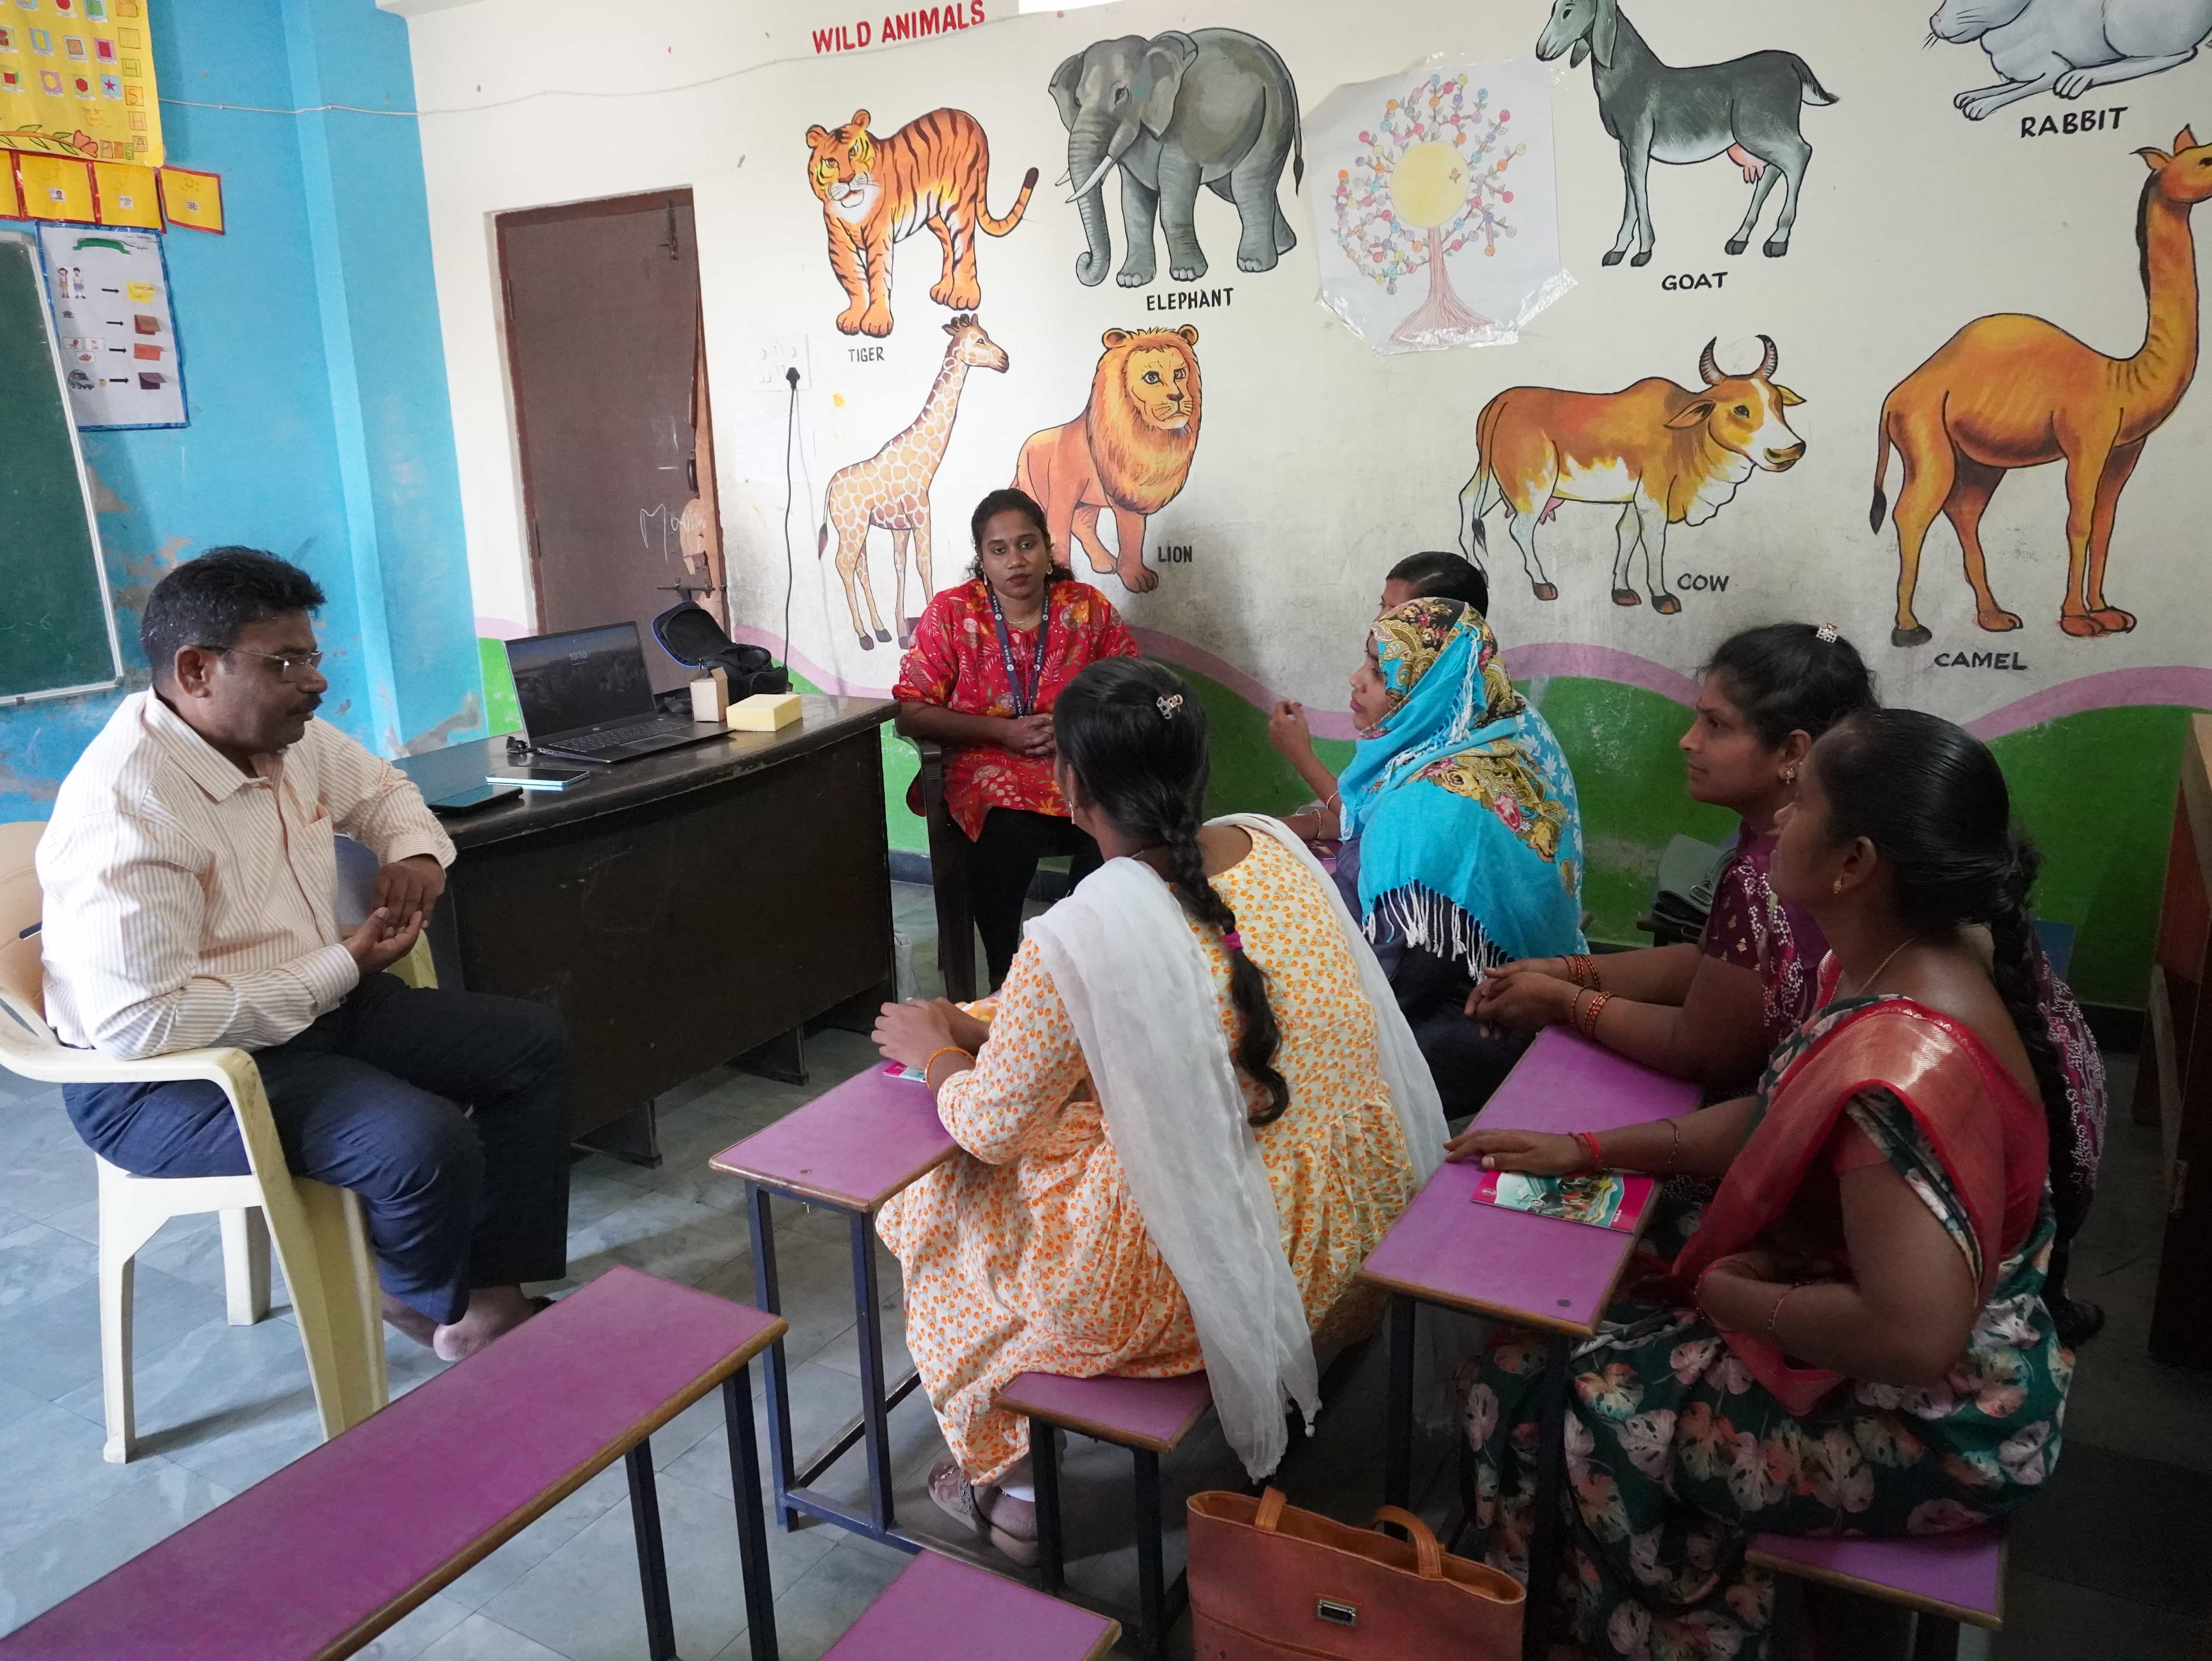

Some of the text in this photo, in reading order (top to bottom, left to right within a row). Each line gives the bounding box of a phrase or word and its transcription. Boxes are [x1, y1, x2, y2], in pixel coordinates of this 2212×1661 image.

[812, 0, 985, 54] WILD ANIMALS
[2021, 106, 2129, 138] RABBIT
[1661, 272, 1728, 291] GOAT
[1147, 287, 1233, 311] ELEPHANT
[848, 346, 884, 362] TIGER
[1158, 546, 1192, 563] LION
[1677, 573, 1729, 592] COW
[1934, 652, 2028, 671] CAMEL
